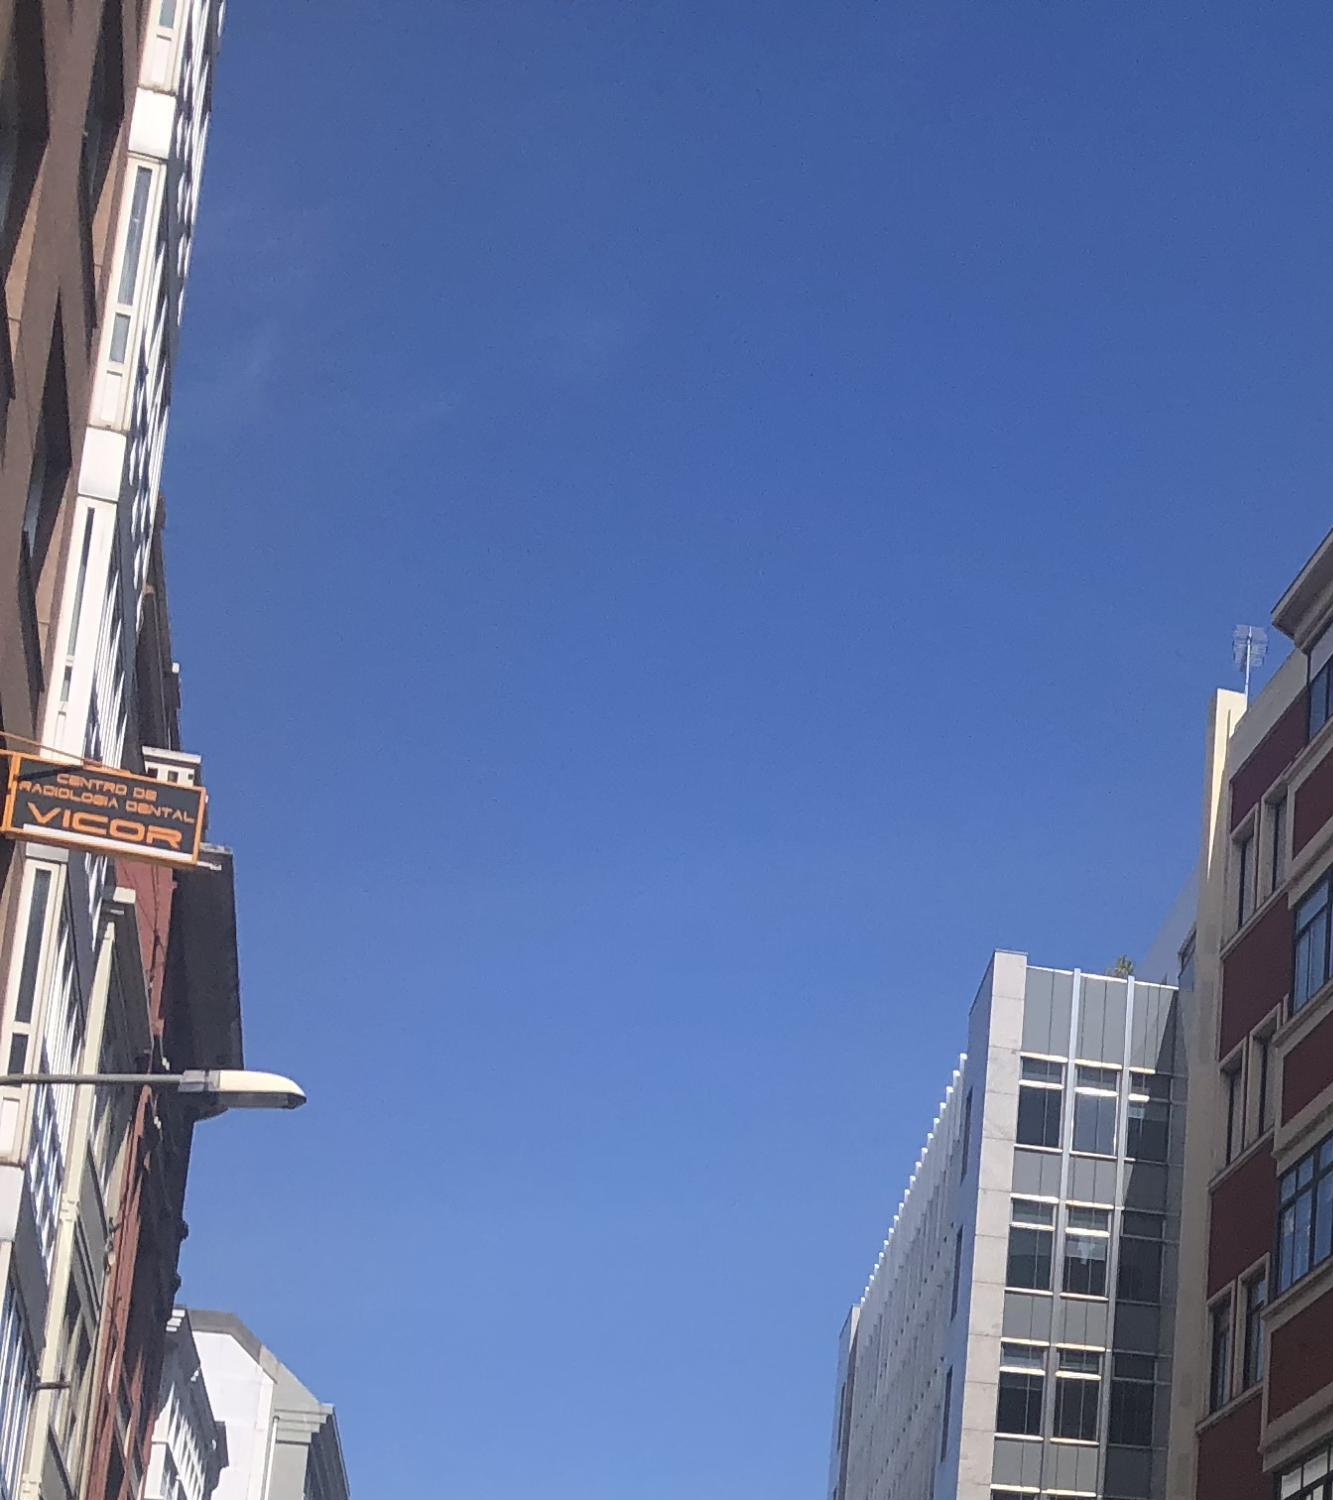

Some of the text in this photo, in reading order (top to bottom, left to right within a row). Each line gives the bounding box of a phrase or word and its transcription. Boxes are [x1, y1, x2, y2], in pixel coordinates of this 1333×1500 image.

[56, 772, 158, 802] CENTRO DE
[27, 801, 183, 850] VICOR
[125, 799, 195, 824] DENTAL
